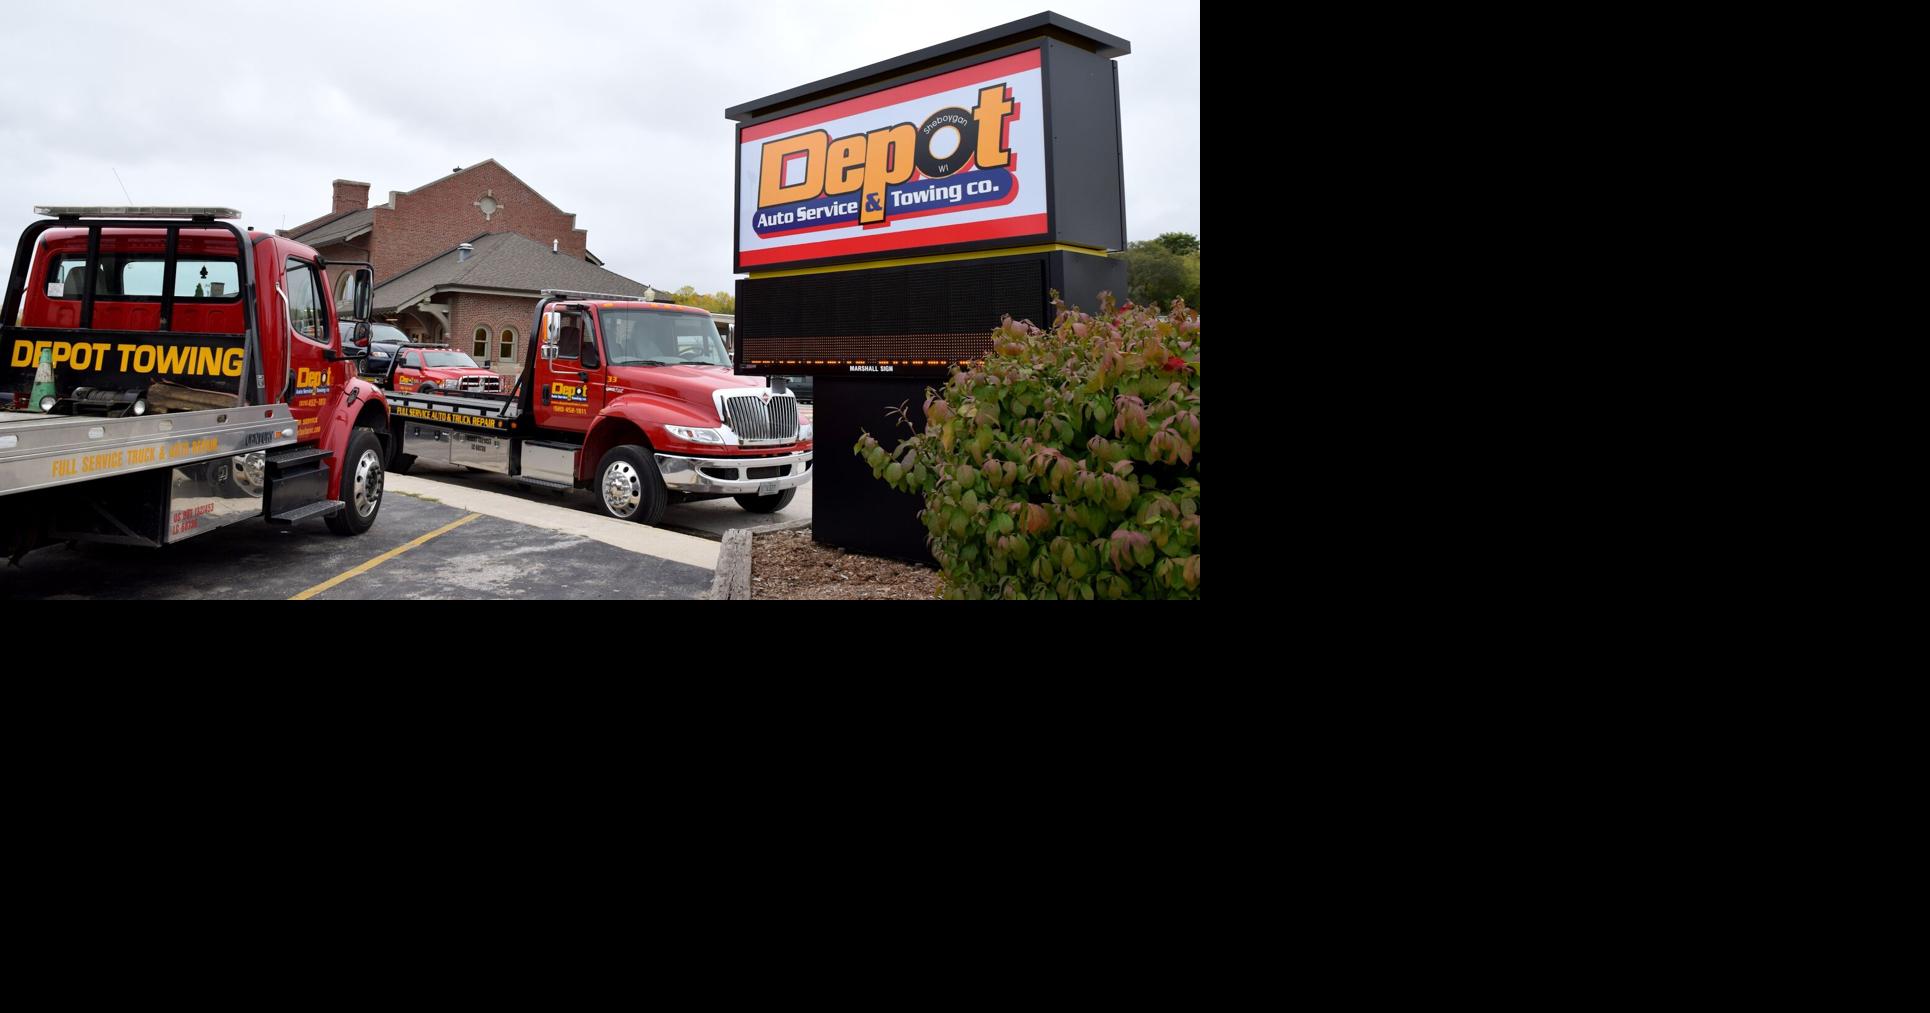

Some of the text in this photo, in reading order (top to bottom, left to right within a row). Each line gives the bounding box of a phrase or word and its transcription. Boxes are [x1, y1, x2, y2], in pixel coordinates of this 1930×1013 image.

[923, 114, 968, 135] Sheboygan
[757, 83, 1018, 225] Depot
[938, 163, 949, 173] WI
[757, 178, 999, 228] Auto Service & Towing co.
[10, 339, 245, 377] DEPOT TOWING
[551, 382, 588, 400] Depot
[397, 406, 409, 416] FULL
[409, 407, 431, 419] SERVICE
[431, 410, 447, 421] AUTO
[452, 414, 471, 425] TRUCK
[472, 416, 495, 428] REPAIR
[52, 458, 78, 478] FULL
[81, 454, 123, 474] SERVICE
[127, 447, 155, 465] TRUCK
